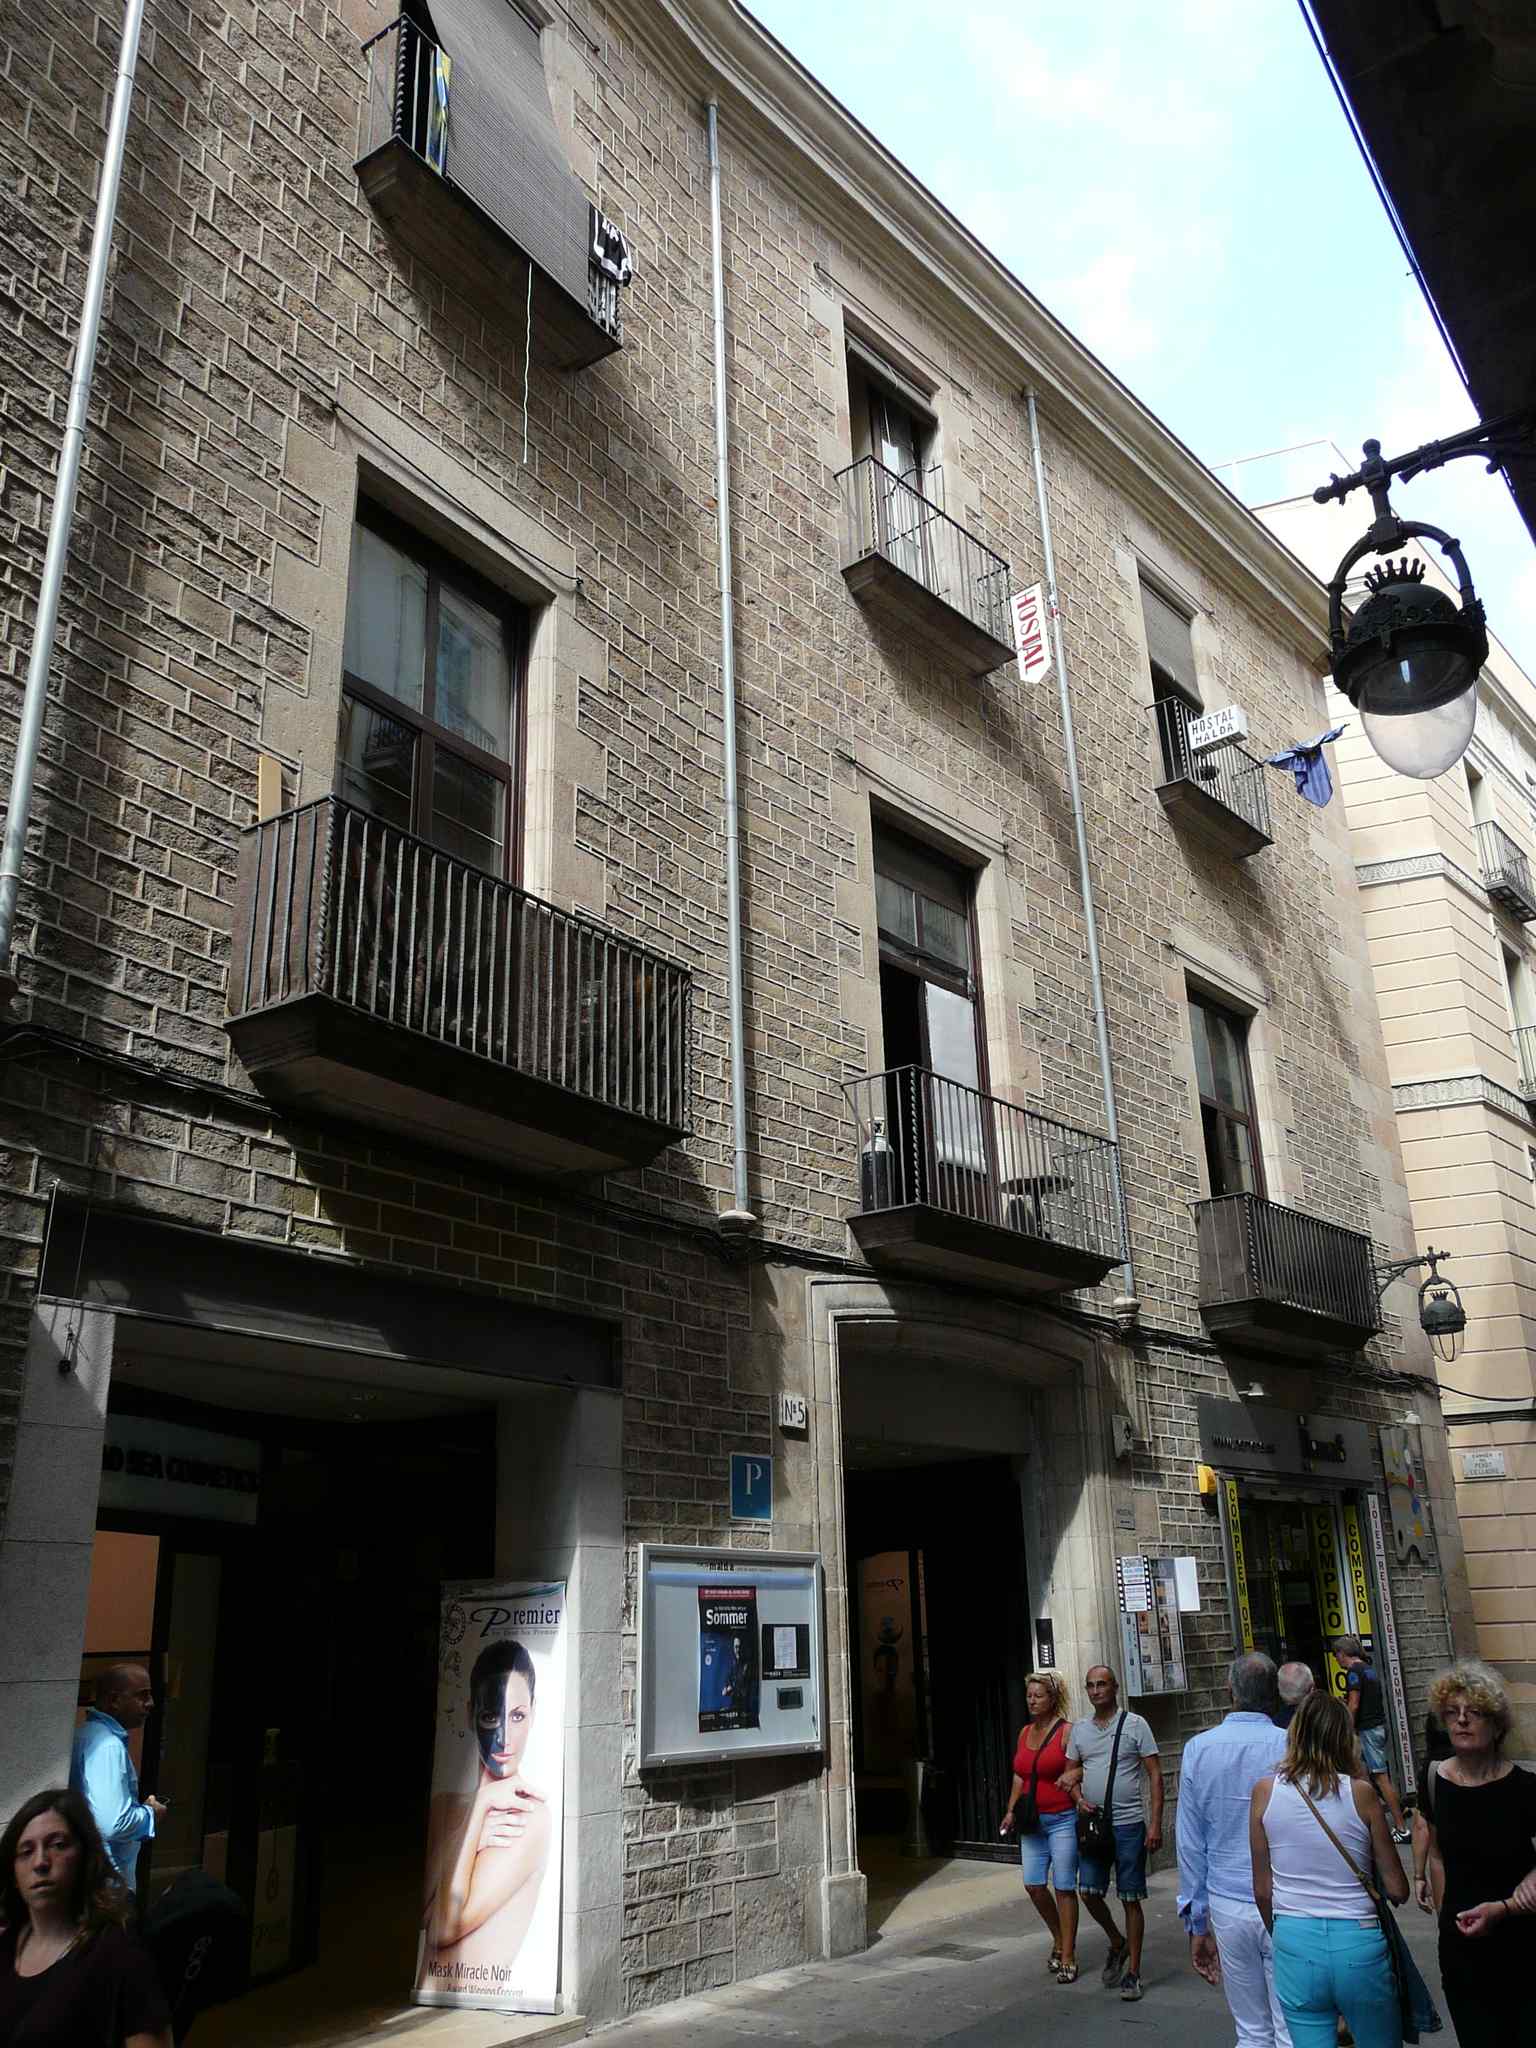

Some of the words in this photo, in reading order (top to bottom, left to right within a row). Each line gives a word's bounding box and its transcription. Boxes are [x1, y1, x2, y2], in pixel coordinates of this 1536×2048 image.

[1016, 589, 1044, 675] HOSTAL
[1191, 708, 1235, 735] HOSTAL
[744, 1462, 762, 1496] P
[1229, 1488, 1248, 1602] COMPREM
[1316, 1513, 1342, 1629] COMPRO
[1348, 1523, 1367, 1614] COMPRO
[470, 1603, 560, 1637] Premier
[706, 1609, 748, 1625] Sommer
[1378, 1560, 1395, 1655] RELLOTGES
[427, 1960, 453, 1977] Mask
[455, 1962, 489, 1981] Miracle
[490, 1965, 512, 1982] Noir
